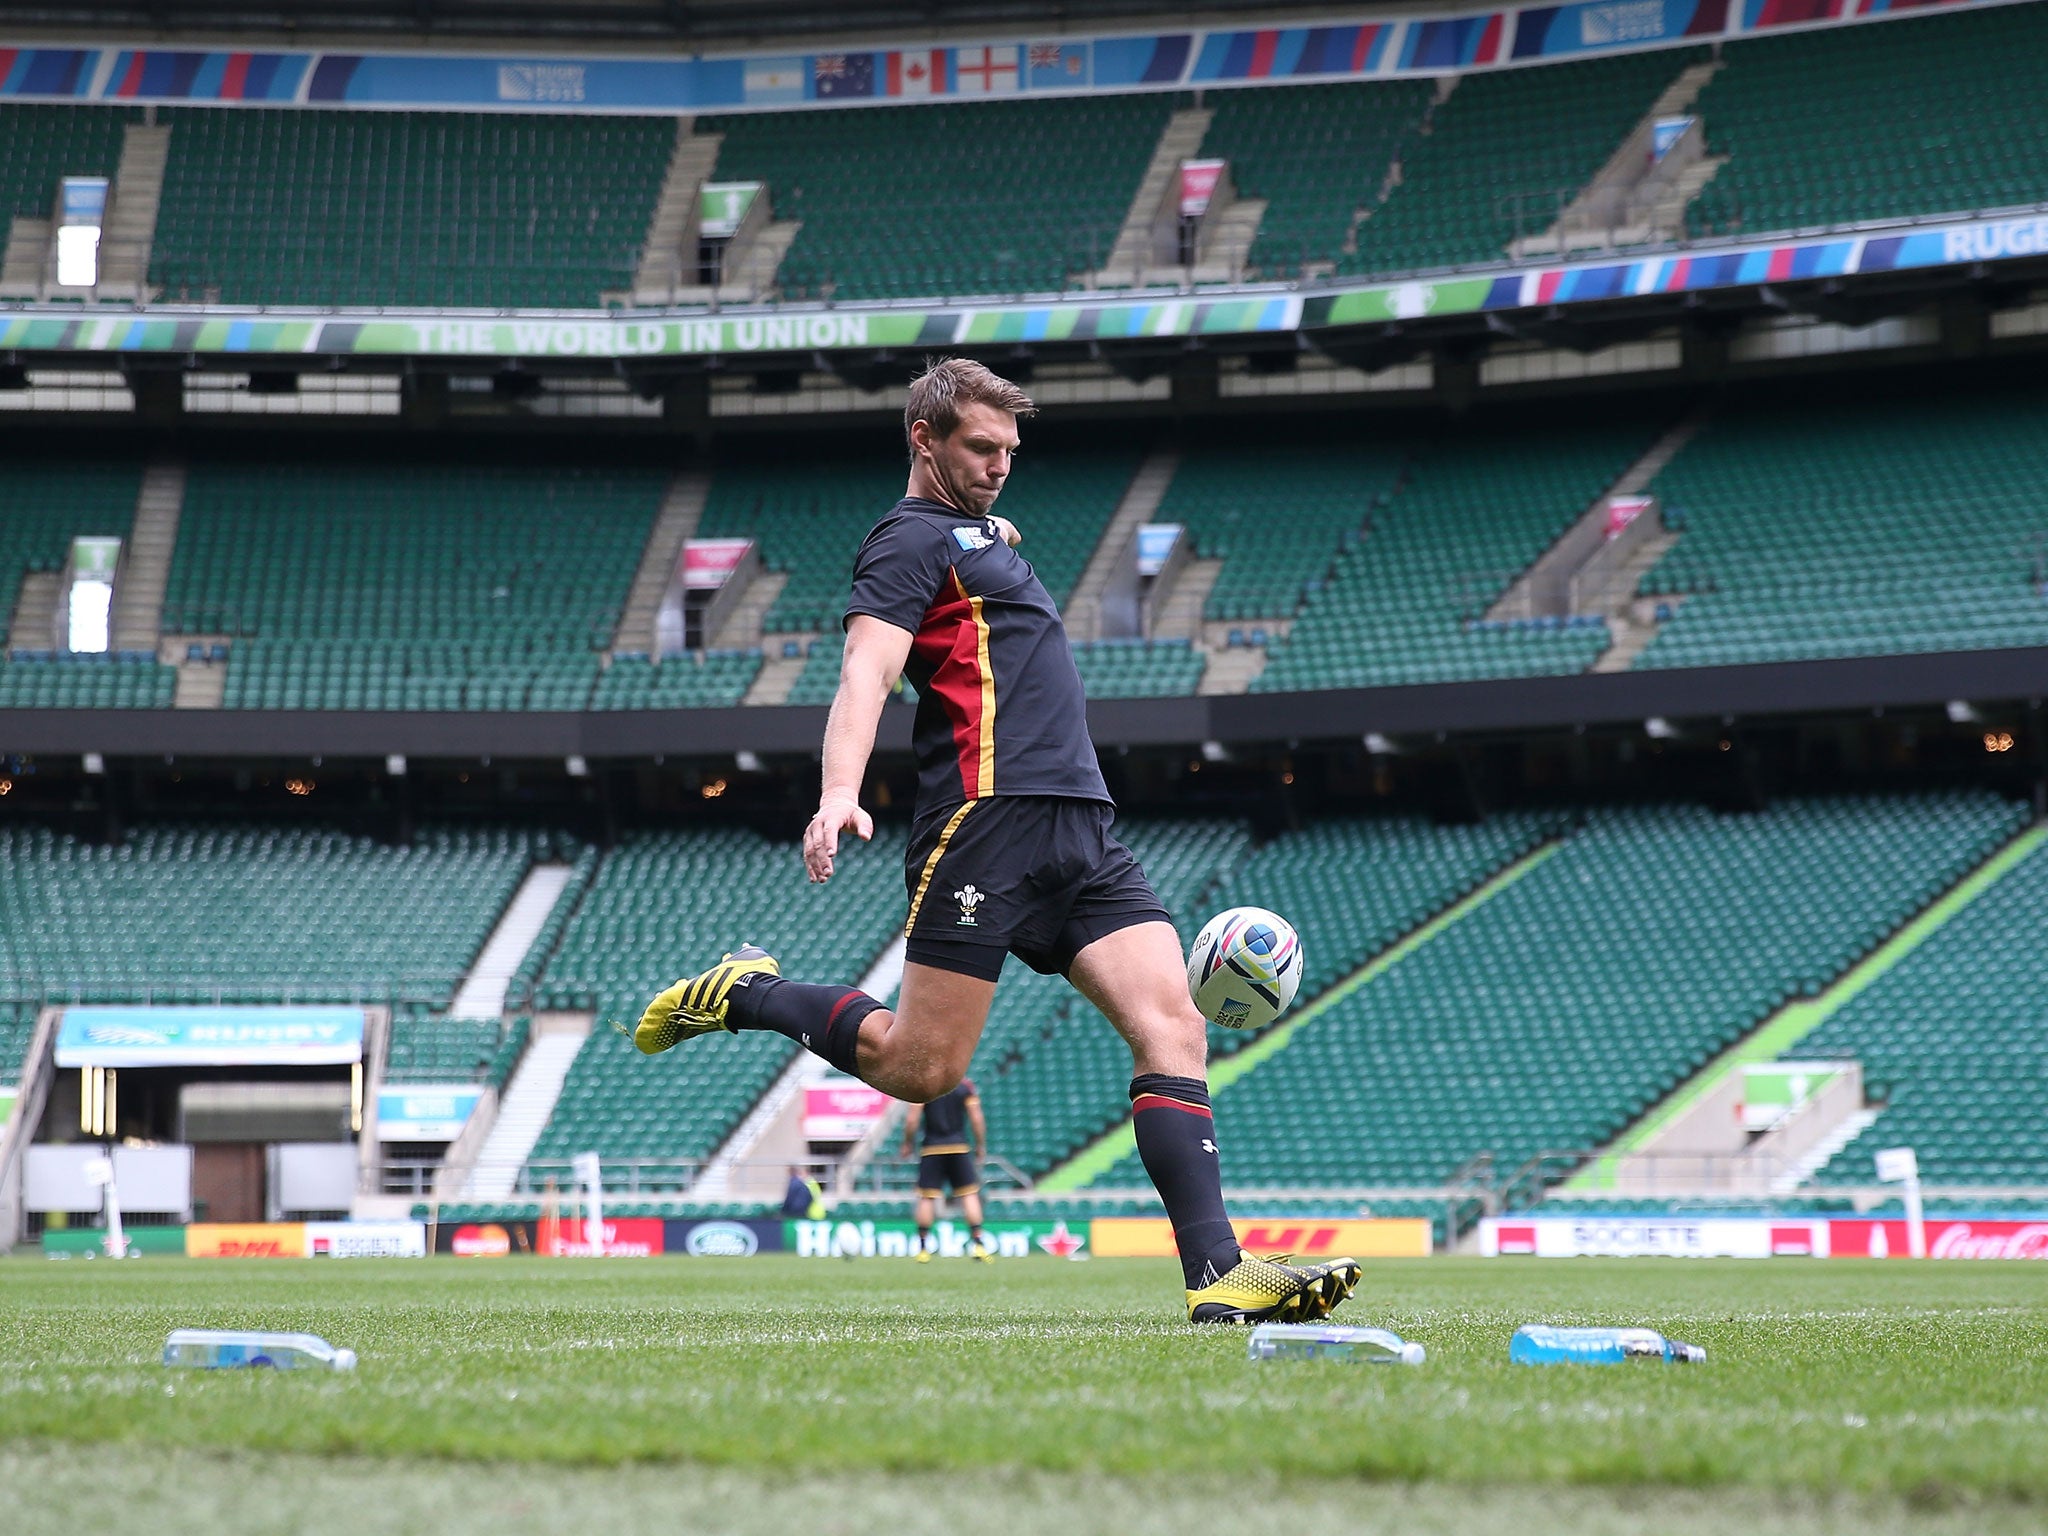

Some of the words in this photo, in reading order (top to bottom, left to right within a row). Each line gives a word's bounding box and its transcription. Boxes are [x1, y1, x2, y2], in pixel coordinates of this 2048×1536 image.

[412, 322, 497, 350] THE
[511, 320, 666, 354] WORLD
[680, 319, 721, 350] IN
[734, 314, 868, 349] UNION
[218, 1241, 284, 1257] DHL
